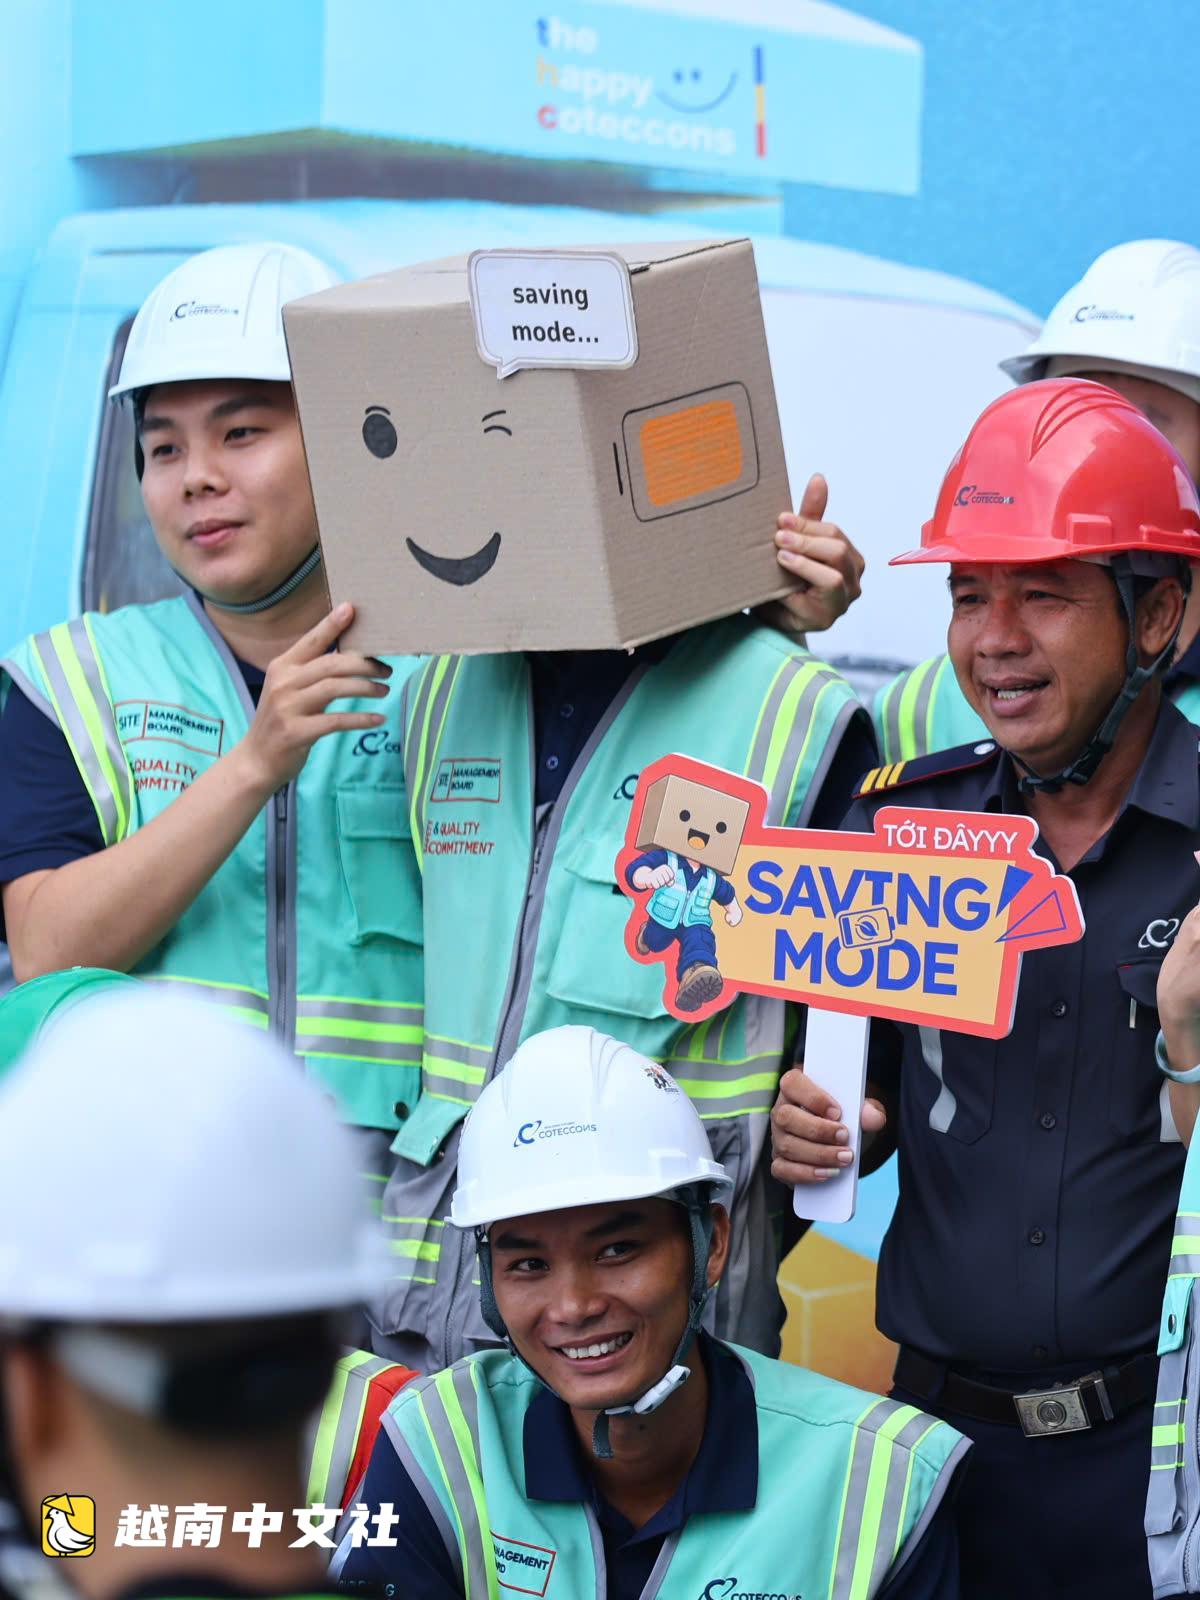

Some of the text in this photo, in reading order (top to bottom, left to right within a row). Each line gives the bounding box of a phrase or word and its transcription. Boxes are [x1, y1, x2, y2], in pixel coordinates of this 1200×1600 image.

[537, 17, 597, 54] the
[536, 55, 654, 108] happy
[537, 105, 736, 154] coteccons
[512, 282, 589, 311] saving
[511, 320, 599, 343] mode...
[118, 713, 141, 731] SITE
[147, 722, 183, 737] BOARD
[148, 709, 219, 737] MANAGEMENT
[134, 759, 198, 781] QUALITY
[440, 821, 480, 836] QUALITY
[883, 819, 1018, 854] TỚI ĐÂYYY
[428, 840, 495, 855] COMMITMENT
[744, 860, 991, 932] SAVING
[773, 929, 958, 996] MODE
[495, 1544, 550, 1571] NAGEMENT
